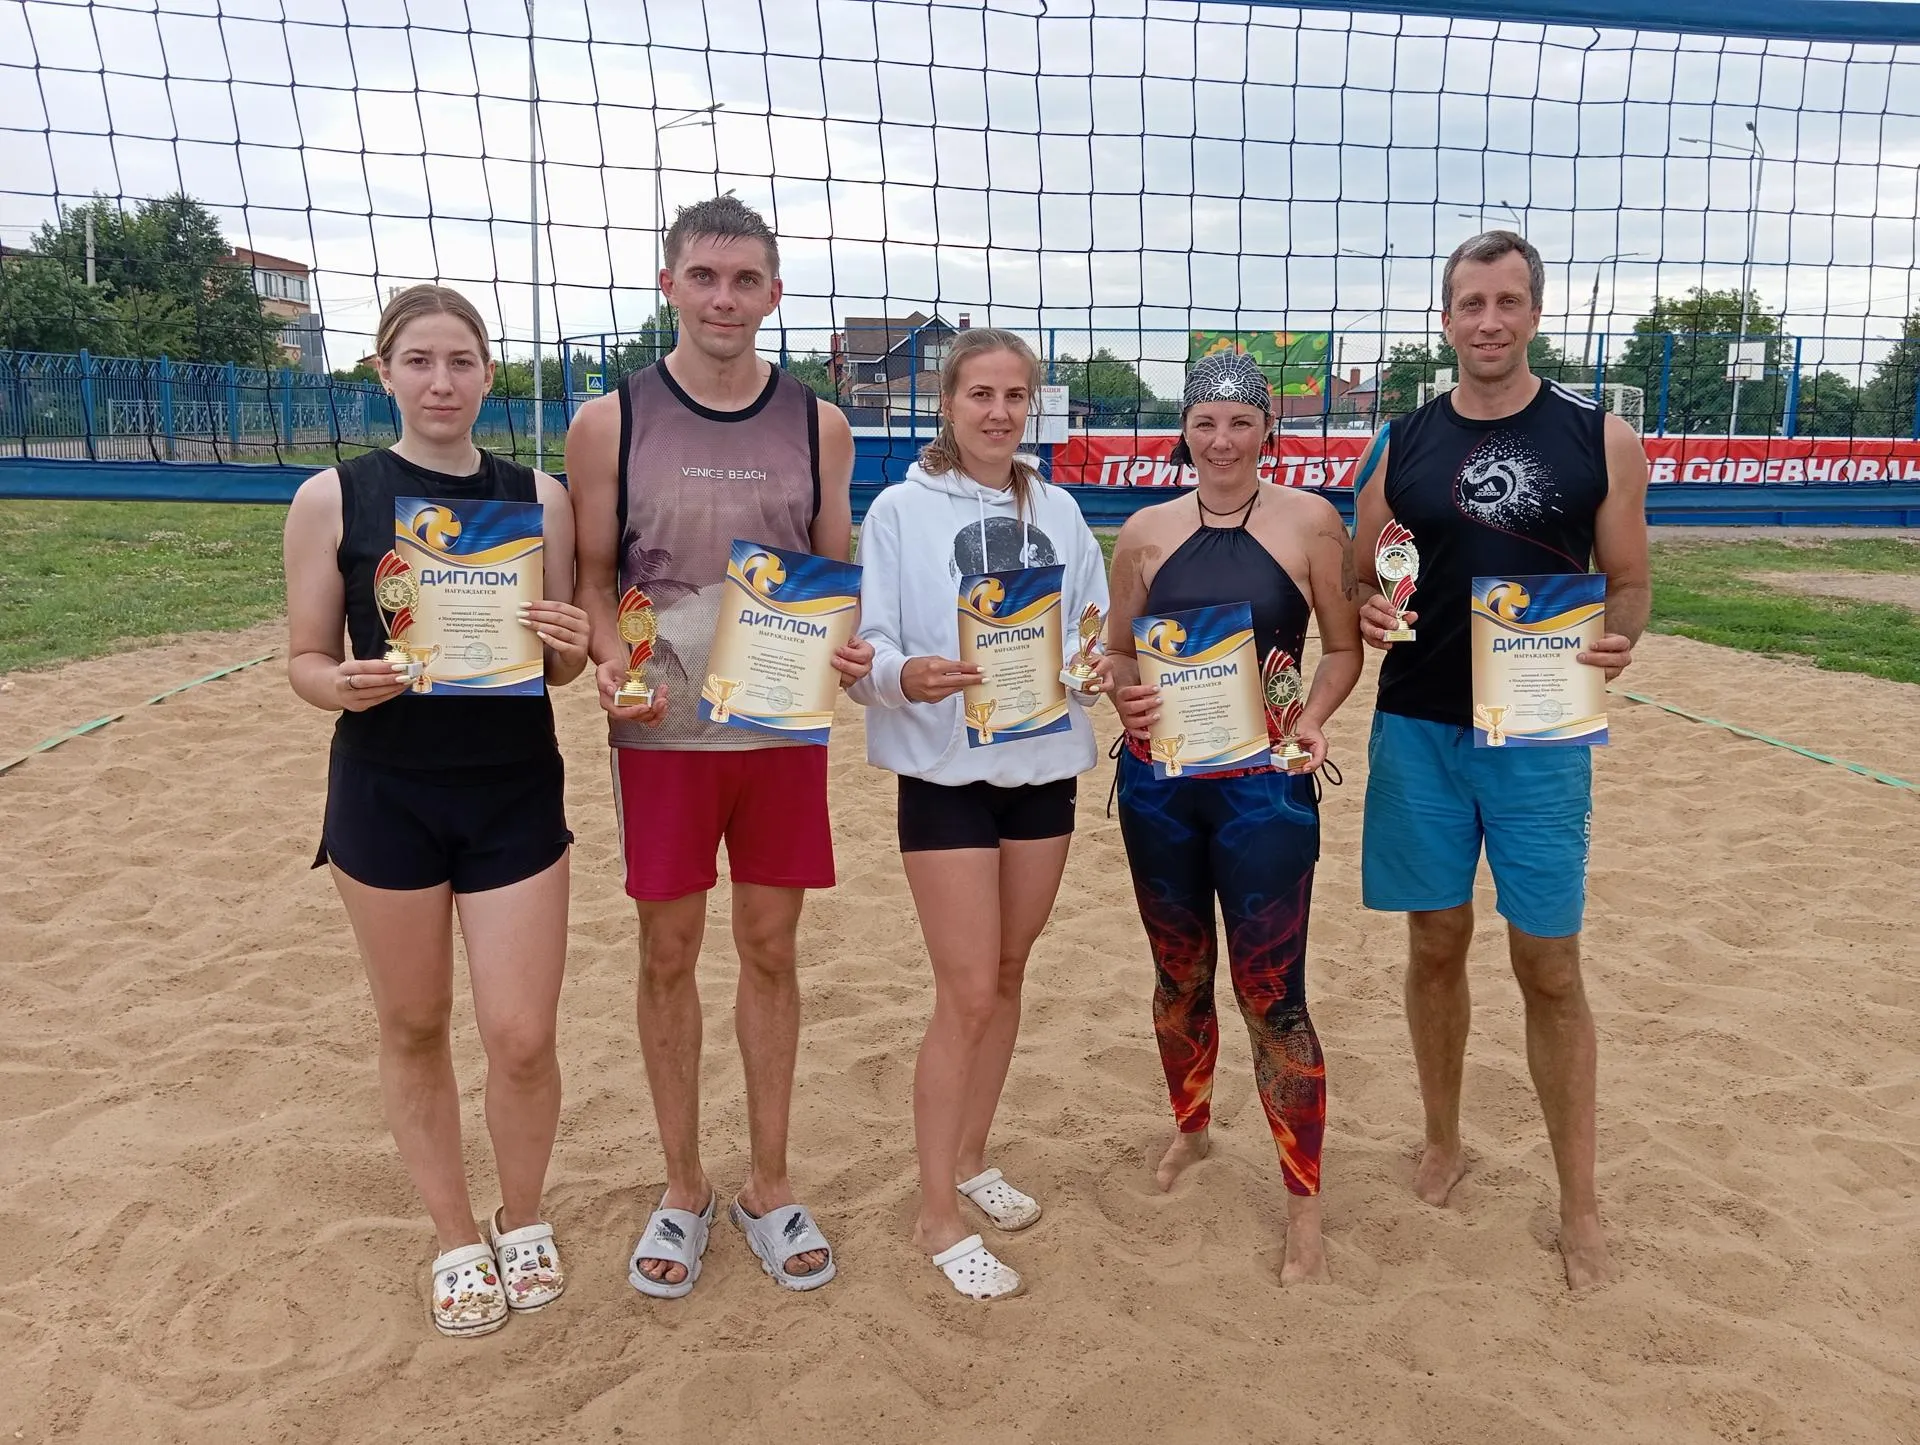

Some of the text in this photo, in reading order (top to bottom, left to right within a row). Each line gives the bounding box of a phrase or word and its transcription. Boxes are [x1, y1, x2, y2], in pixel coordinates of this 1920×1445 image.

[681, 467, 766, 481] VENICE BEACH
[420, 569, 518, 586] ДИПЛОМ
[444, 587, 497, 595] НАГРАЖДАЕТСЯ
[738, 609, 827, 639] ДИПЛОМ
[758, 630, 805, 644] НАГРАЖДАЕТСЯ
[976, 626, 1044, 650] ДИПЛОМ
[1492, 636, 1581, 653] ДИПЛОМ
[1160, 663, 1238, 688] ДИПЛОМ
